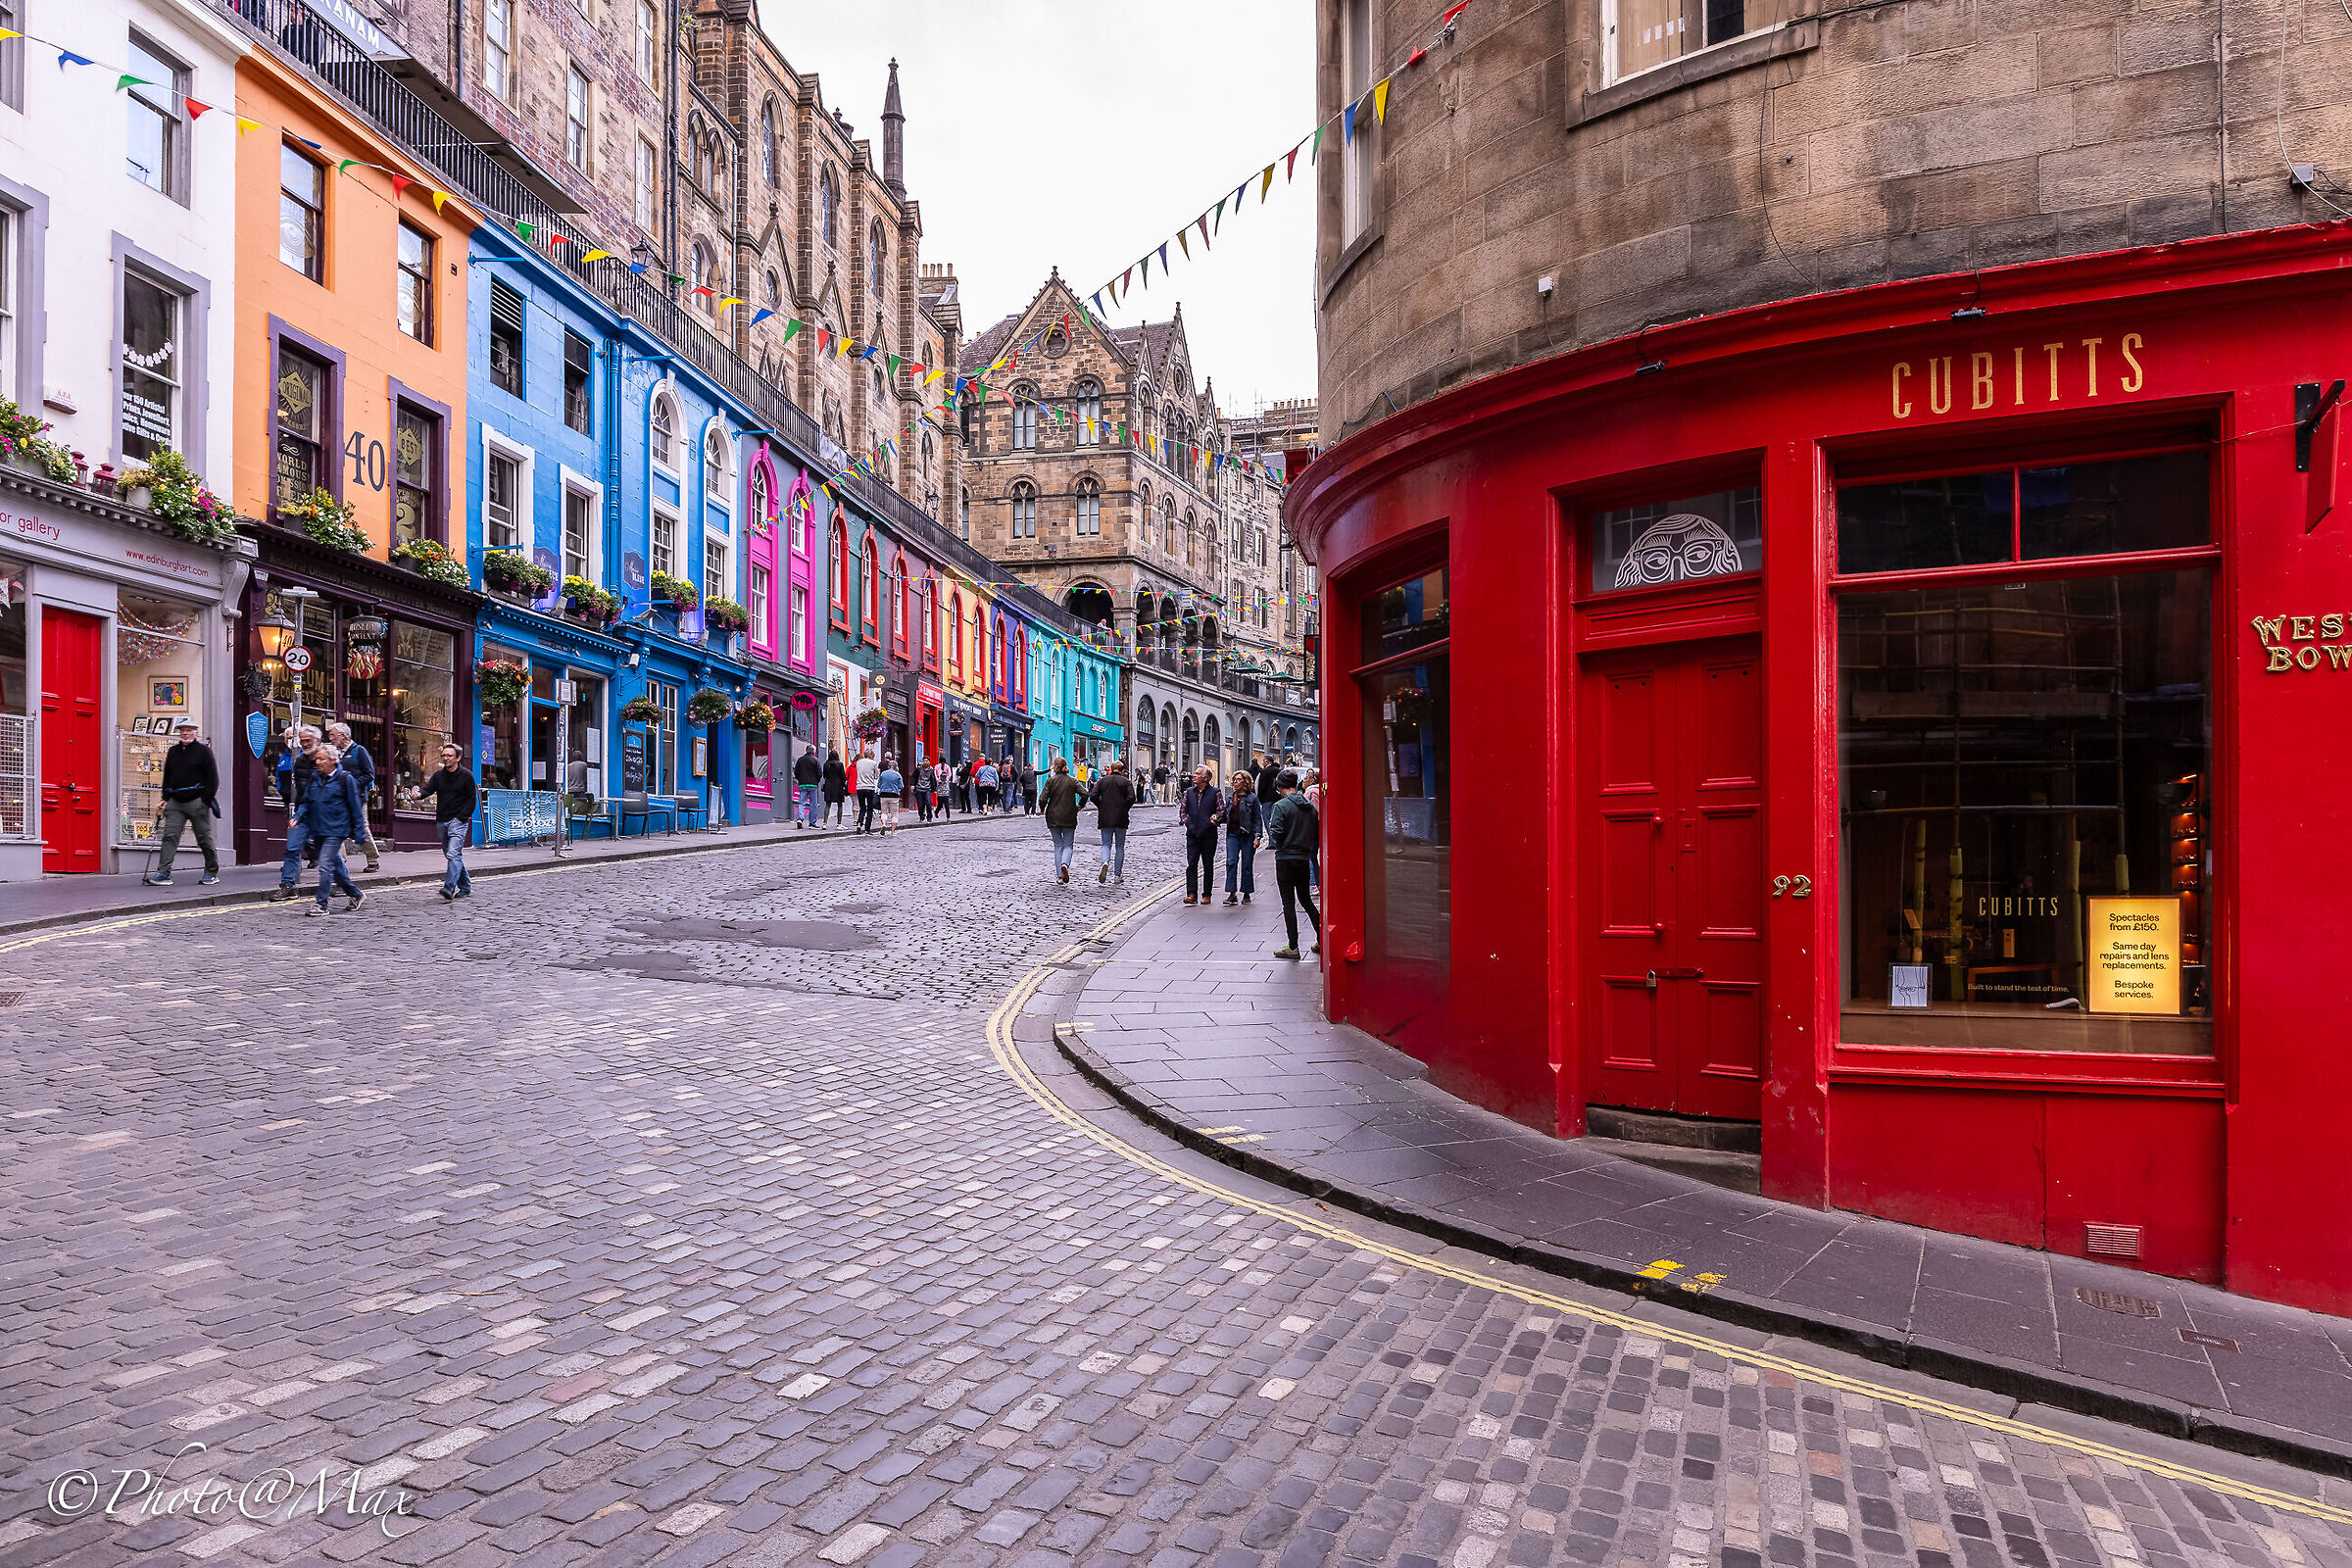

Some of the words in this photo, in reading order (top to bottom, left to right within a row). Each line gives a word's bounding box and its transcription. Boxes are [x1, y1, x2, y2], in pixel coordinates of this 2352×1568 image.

[321, 0, 380, 50] ANAM
[1892, 332, 2143, 419] CUBITTS
[133, 395, 144, 406] 150
[401, 438, 418, 458] BEST
[345, 431, 386, 492] 40
[276, 463, 307, 481] AMOUS
[19, 516, 61, 541] gallery
[125, 549, 209, 578] www.edinburghart.com
[287, 652, 310, 665] 20
[2267, 645, 2352, 671] BOW
[1773, 874, 1811, 897] 92
[1979, 897, 2059, 916] CUBITTS
[2109, 913, 2160, 922] Spectacles
[2109, 922, 2131, 931] from
[2139, 942, 2157, 952] day
[2099, 953, 2132, 962] repairs
[2132, 952, 2149, 960] and
[2151, 952, 2170, 960] lens
[2102, 961, 2167, 970] replacements.
[2051, 985, 2070, 994] time.
[2114, 980, 2154, 989] Bespoke
[2114, 990, 2154, 999] services.
